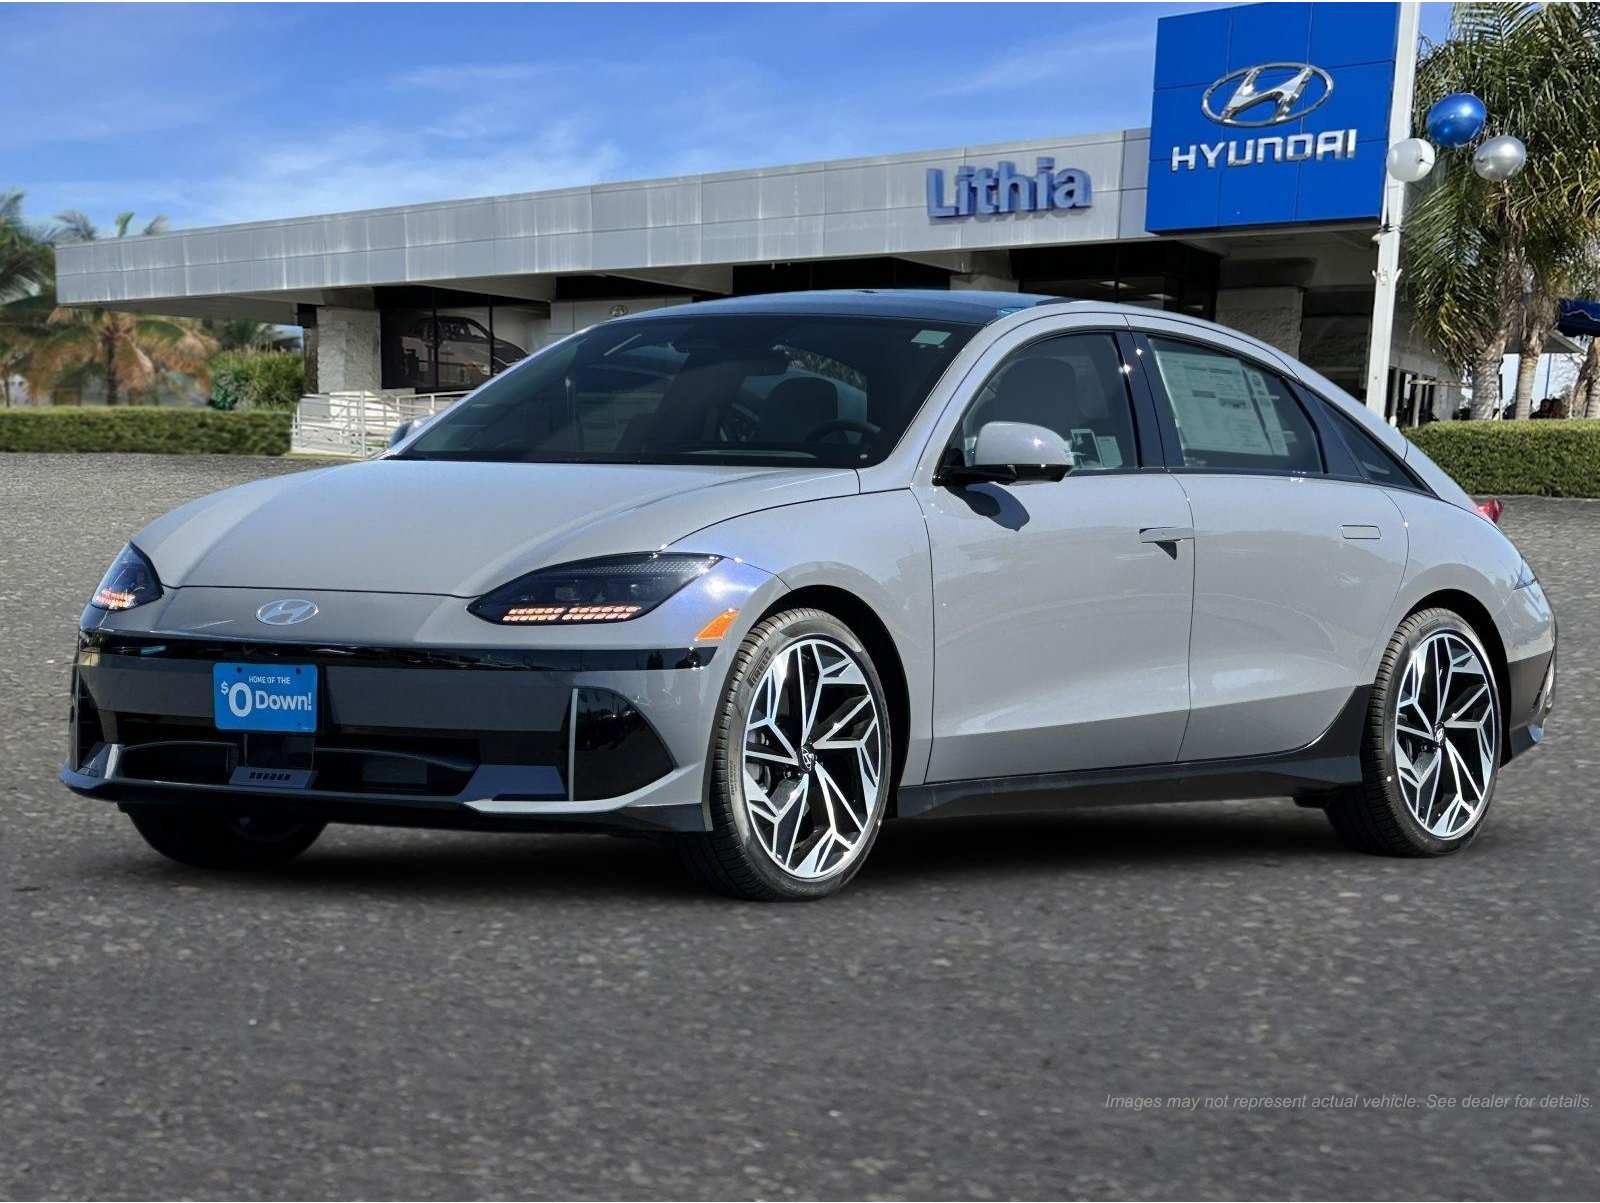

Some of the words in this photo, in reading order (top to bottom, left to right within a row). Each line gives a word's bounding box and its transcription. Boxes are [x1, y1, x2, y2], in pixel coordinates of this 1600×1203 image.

[1171, 129, 1357, 171] HYUNDAI
[926, 156, 1093, 217] Lithia
[249, 676, 266, 684] HOME
[277, 677, 291, 685] THE
[255, 690, 312, 711] Down!
